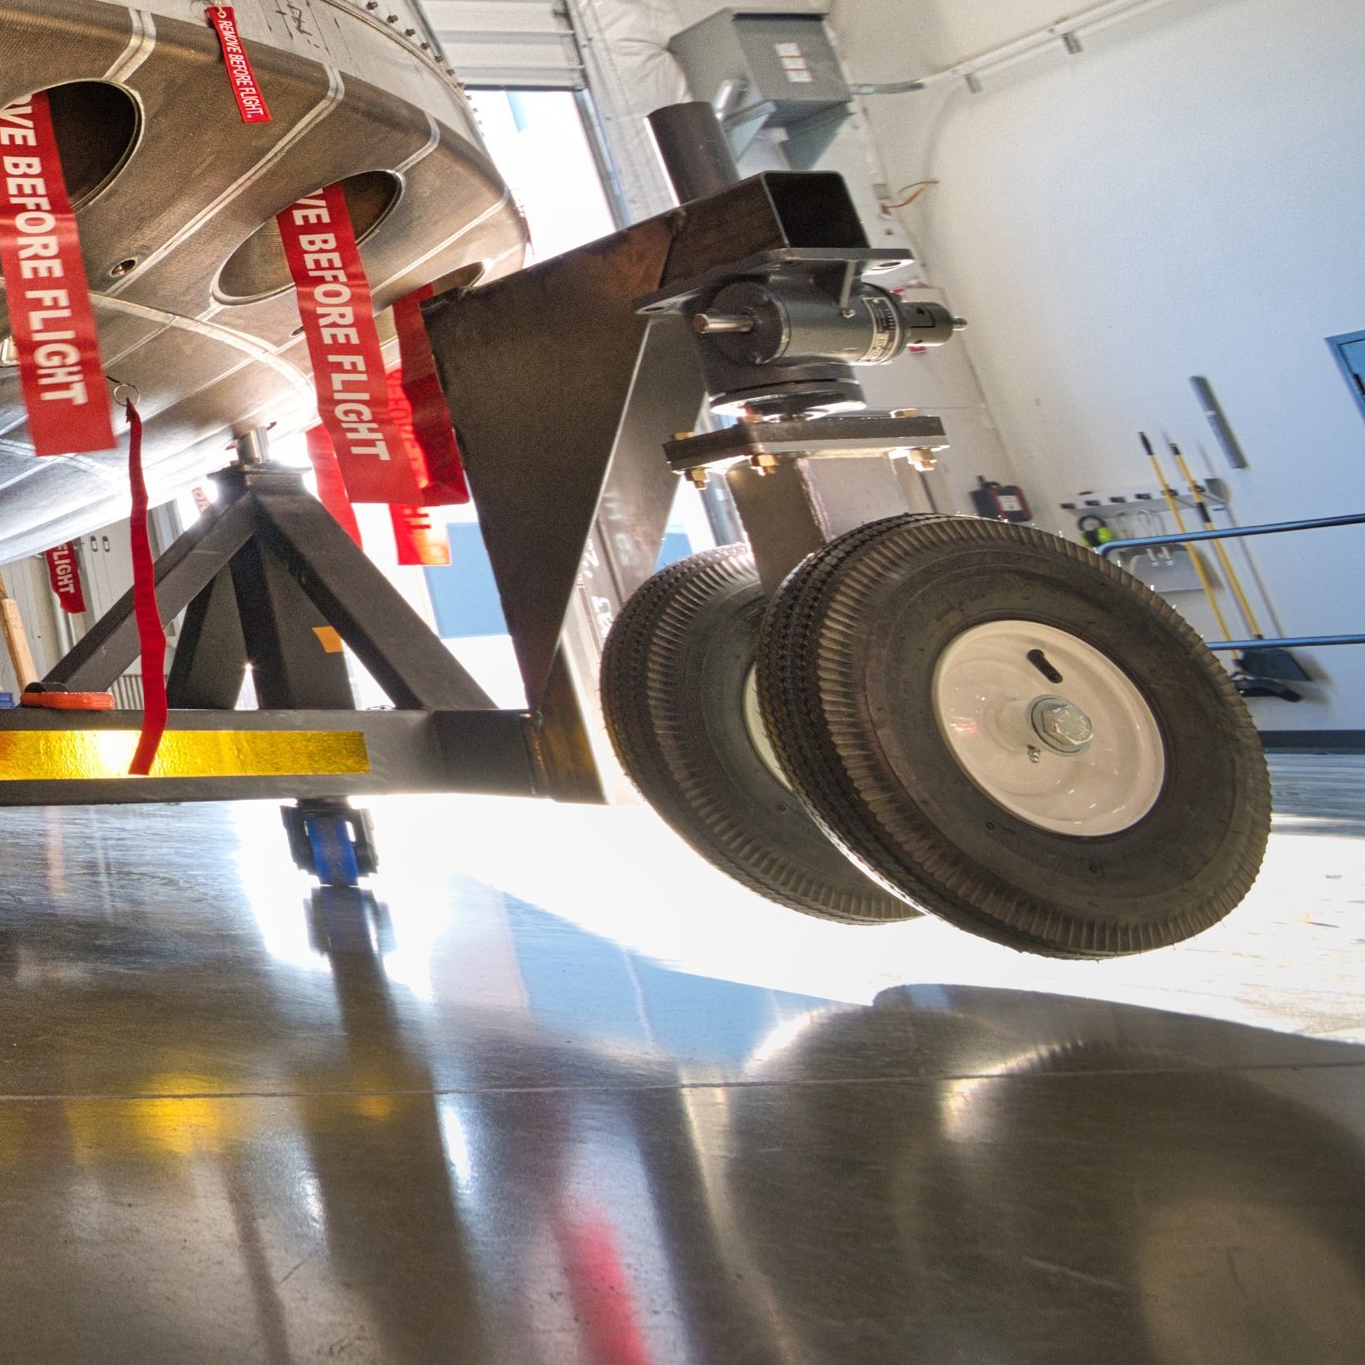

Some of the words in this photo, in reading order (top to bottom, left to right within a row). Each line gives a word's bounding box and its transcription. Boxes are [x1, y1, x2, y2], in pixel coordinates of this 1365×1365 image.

[218, 20, 241, 54] REMOVE
[229, 53, 253, 86] BEFORE
[3, 155, 66, 279] BEFORE
[299, 233, 360, 345] BEFORE
[25, 290, 87, 406] FLIGHT
[326, 355, 391, 461] FLIGHT
